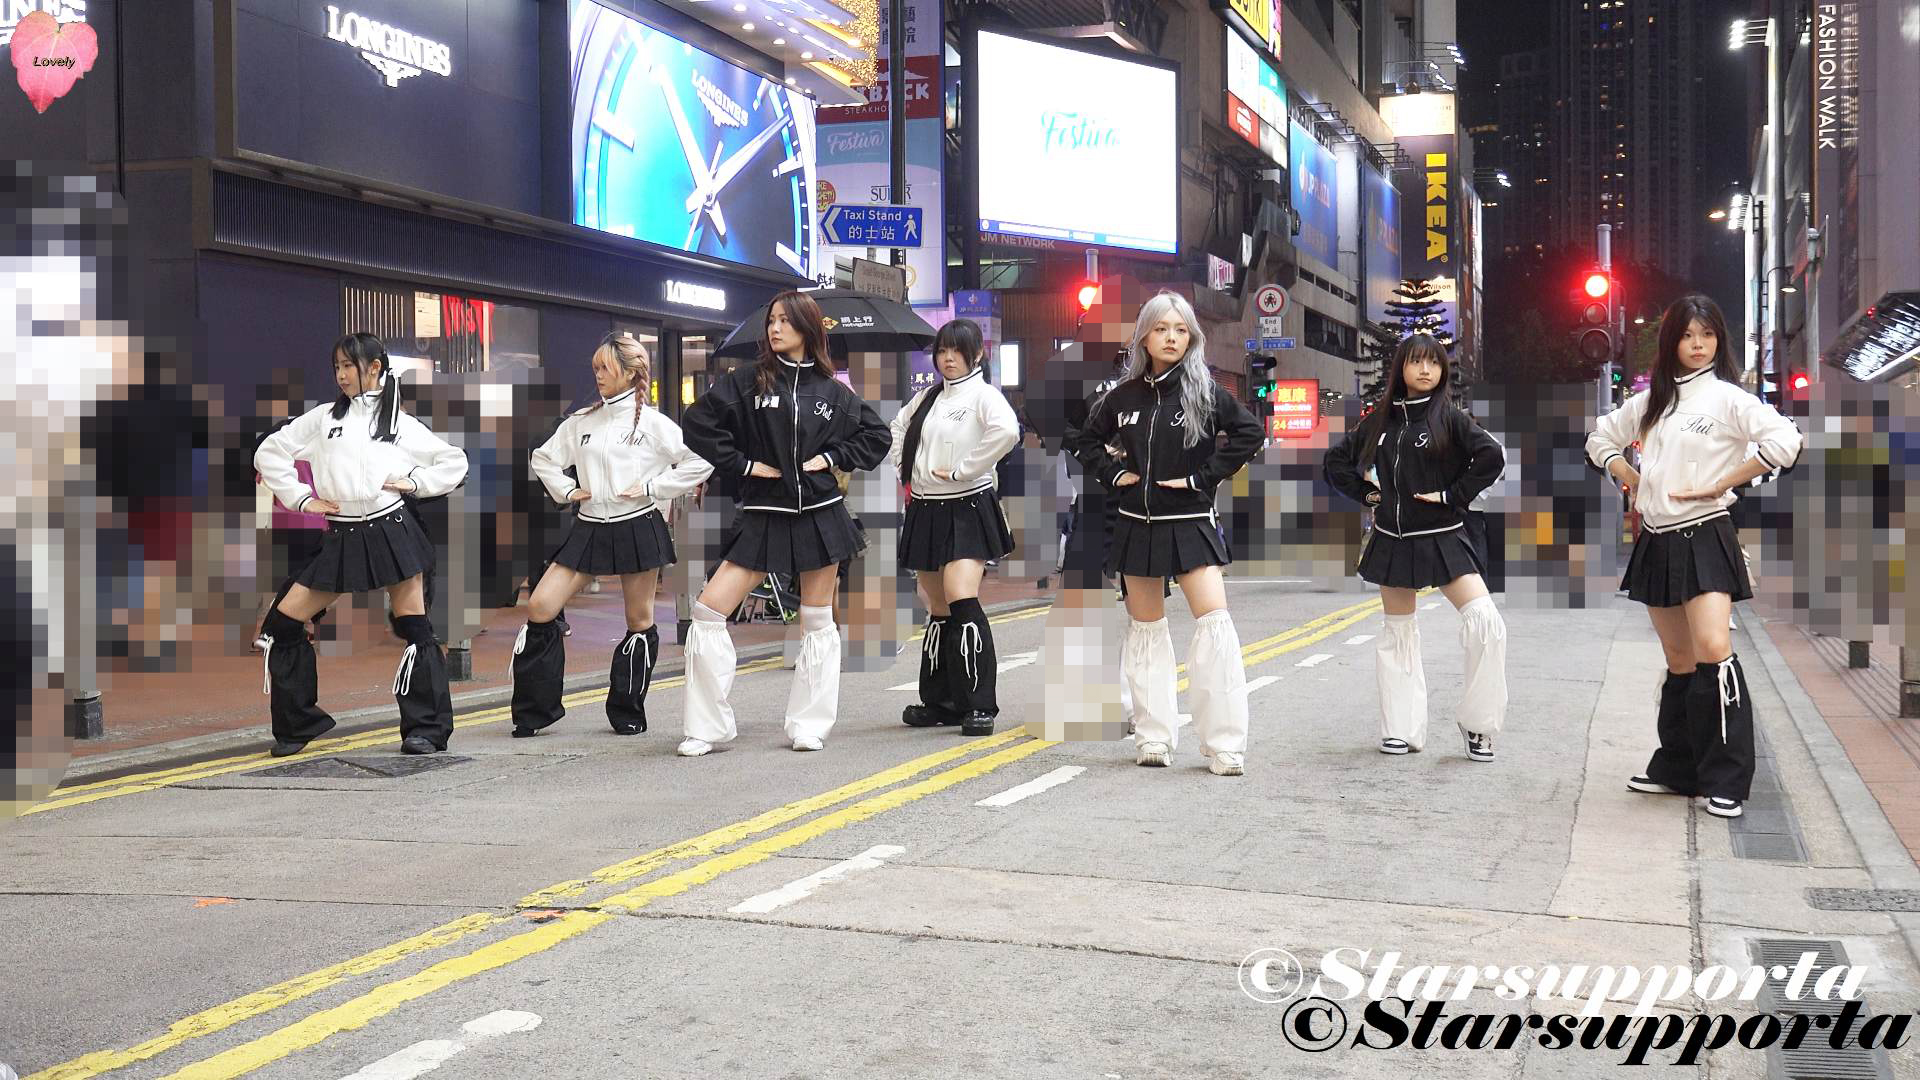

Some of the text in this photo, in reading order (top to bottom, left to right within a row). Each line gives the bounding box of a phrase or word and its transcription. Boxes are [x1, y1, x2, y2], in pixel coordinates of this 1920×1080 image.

[327, 5, 451, 77] LONGINES
[1818, 4, 1837, 149] FASHION WALK
[827, 129, 885, 156] Festiva
[843, 210, 902, 221] Taxi Stand
[1425, 153, 1448, 262] IKEA
[848, 225, 895, 241] 的士站
[980, 233, 1056, 249] JM NETWORK
[1273, 420, 1287, 430] 24
